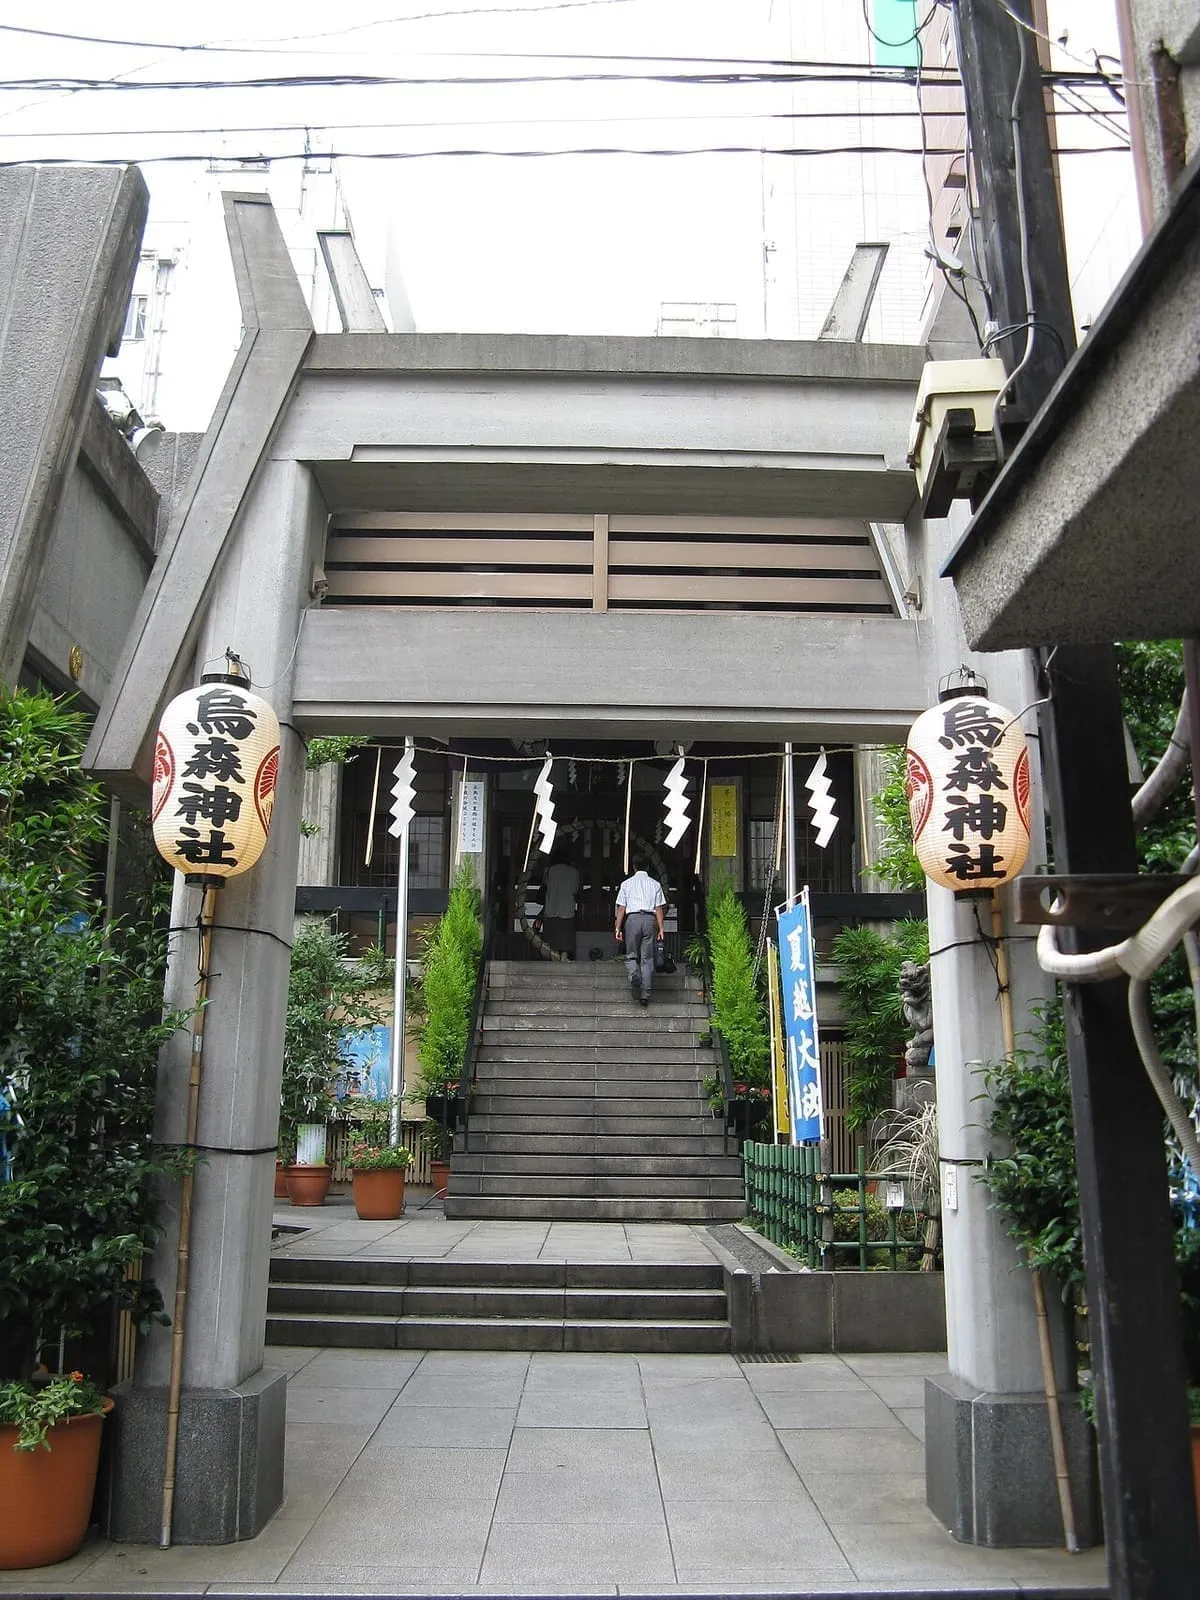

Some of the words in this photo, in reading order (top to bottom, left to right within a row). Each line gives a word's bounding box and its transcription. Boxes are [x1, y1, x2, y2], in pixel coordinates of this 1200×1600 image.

[174, 688, 257, 867] 烏森神社
[938, 702, 1008, 880] 烏森神社
